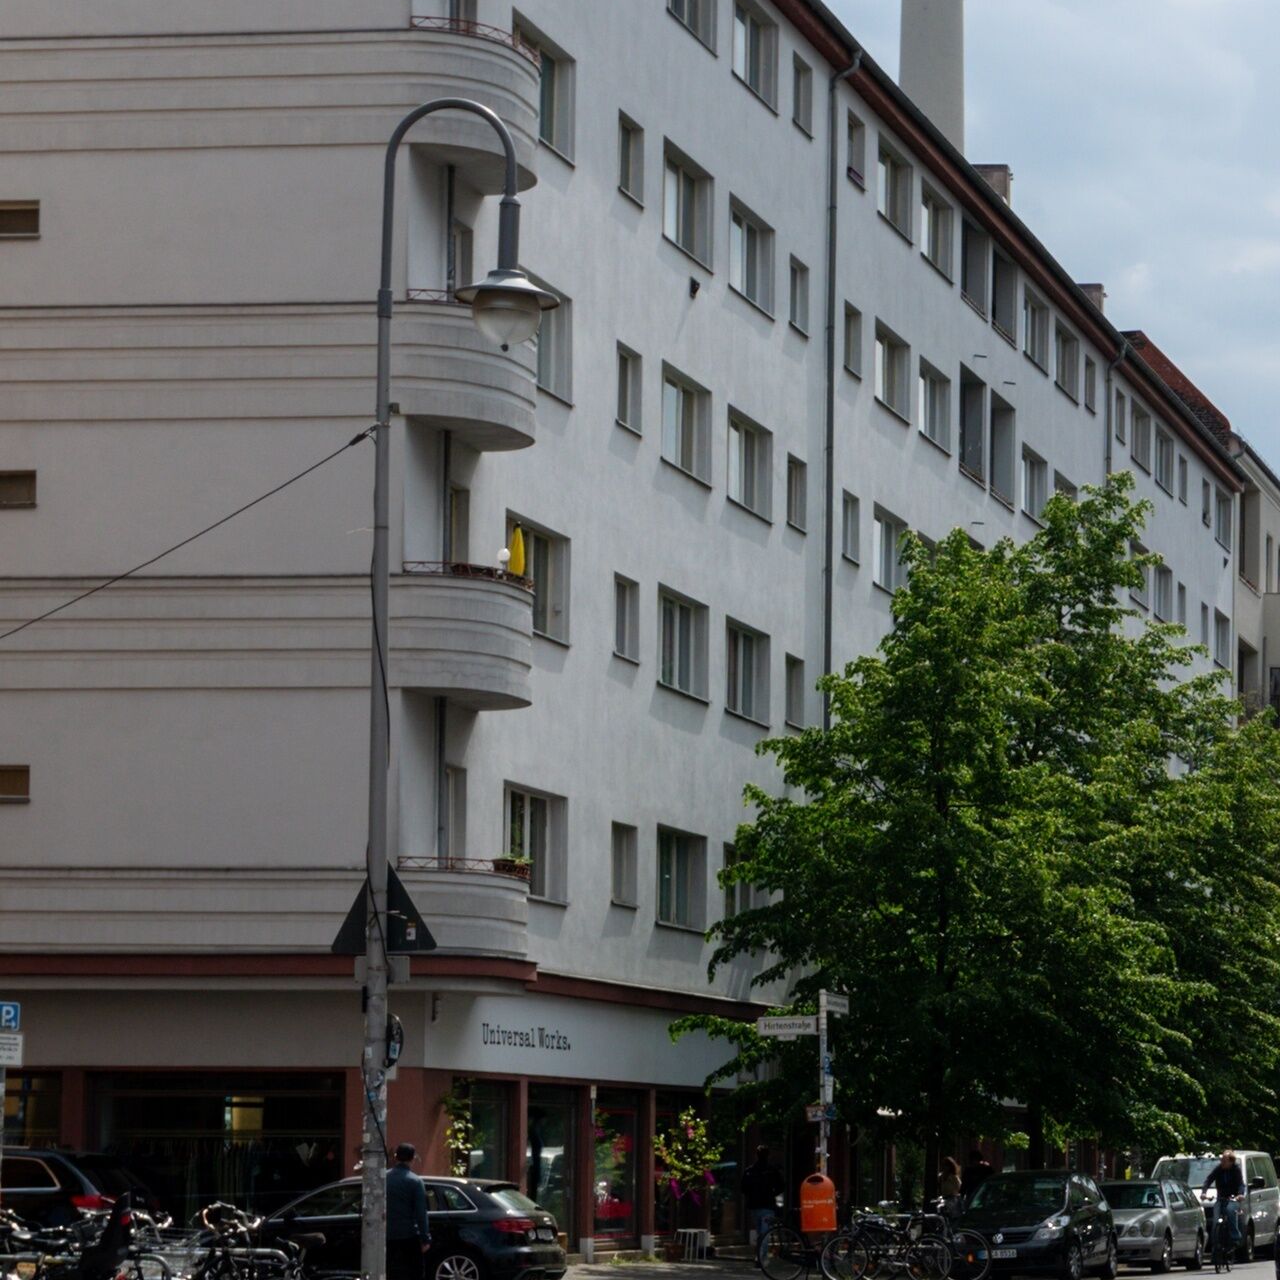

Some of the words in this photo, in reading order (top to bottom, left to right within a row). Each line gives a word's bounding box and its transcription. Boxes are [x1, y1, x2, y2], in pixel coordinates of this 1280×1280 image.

[763, 1021, 811, 1031] Hirtenstraße
[482, 1023, 536, 1048] Universal
[537, 1027, 571, 1051] Works.
